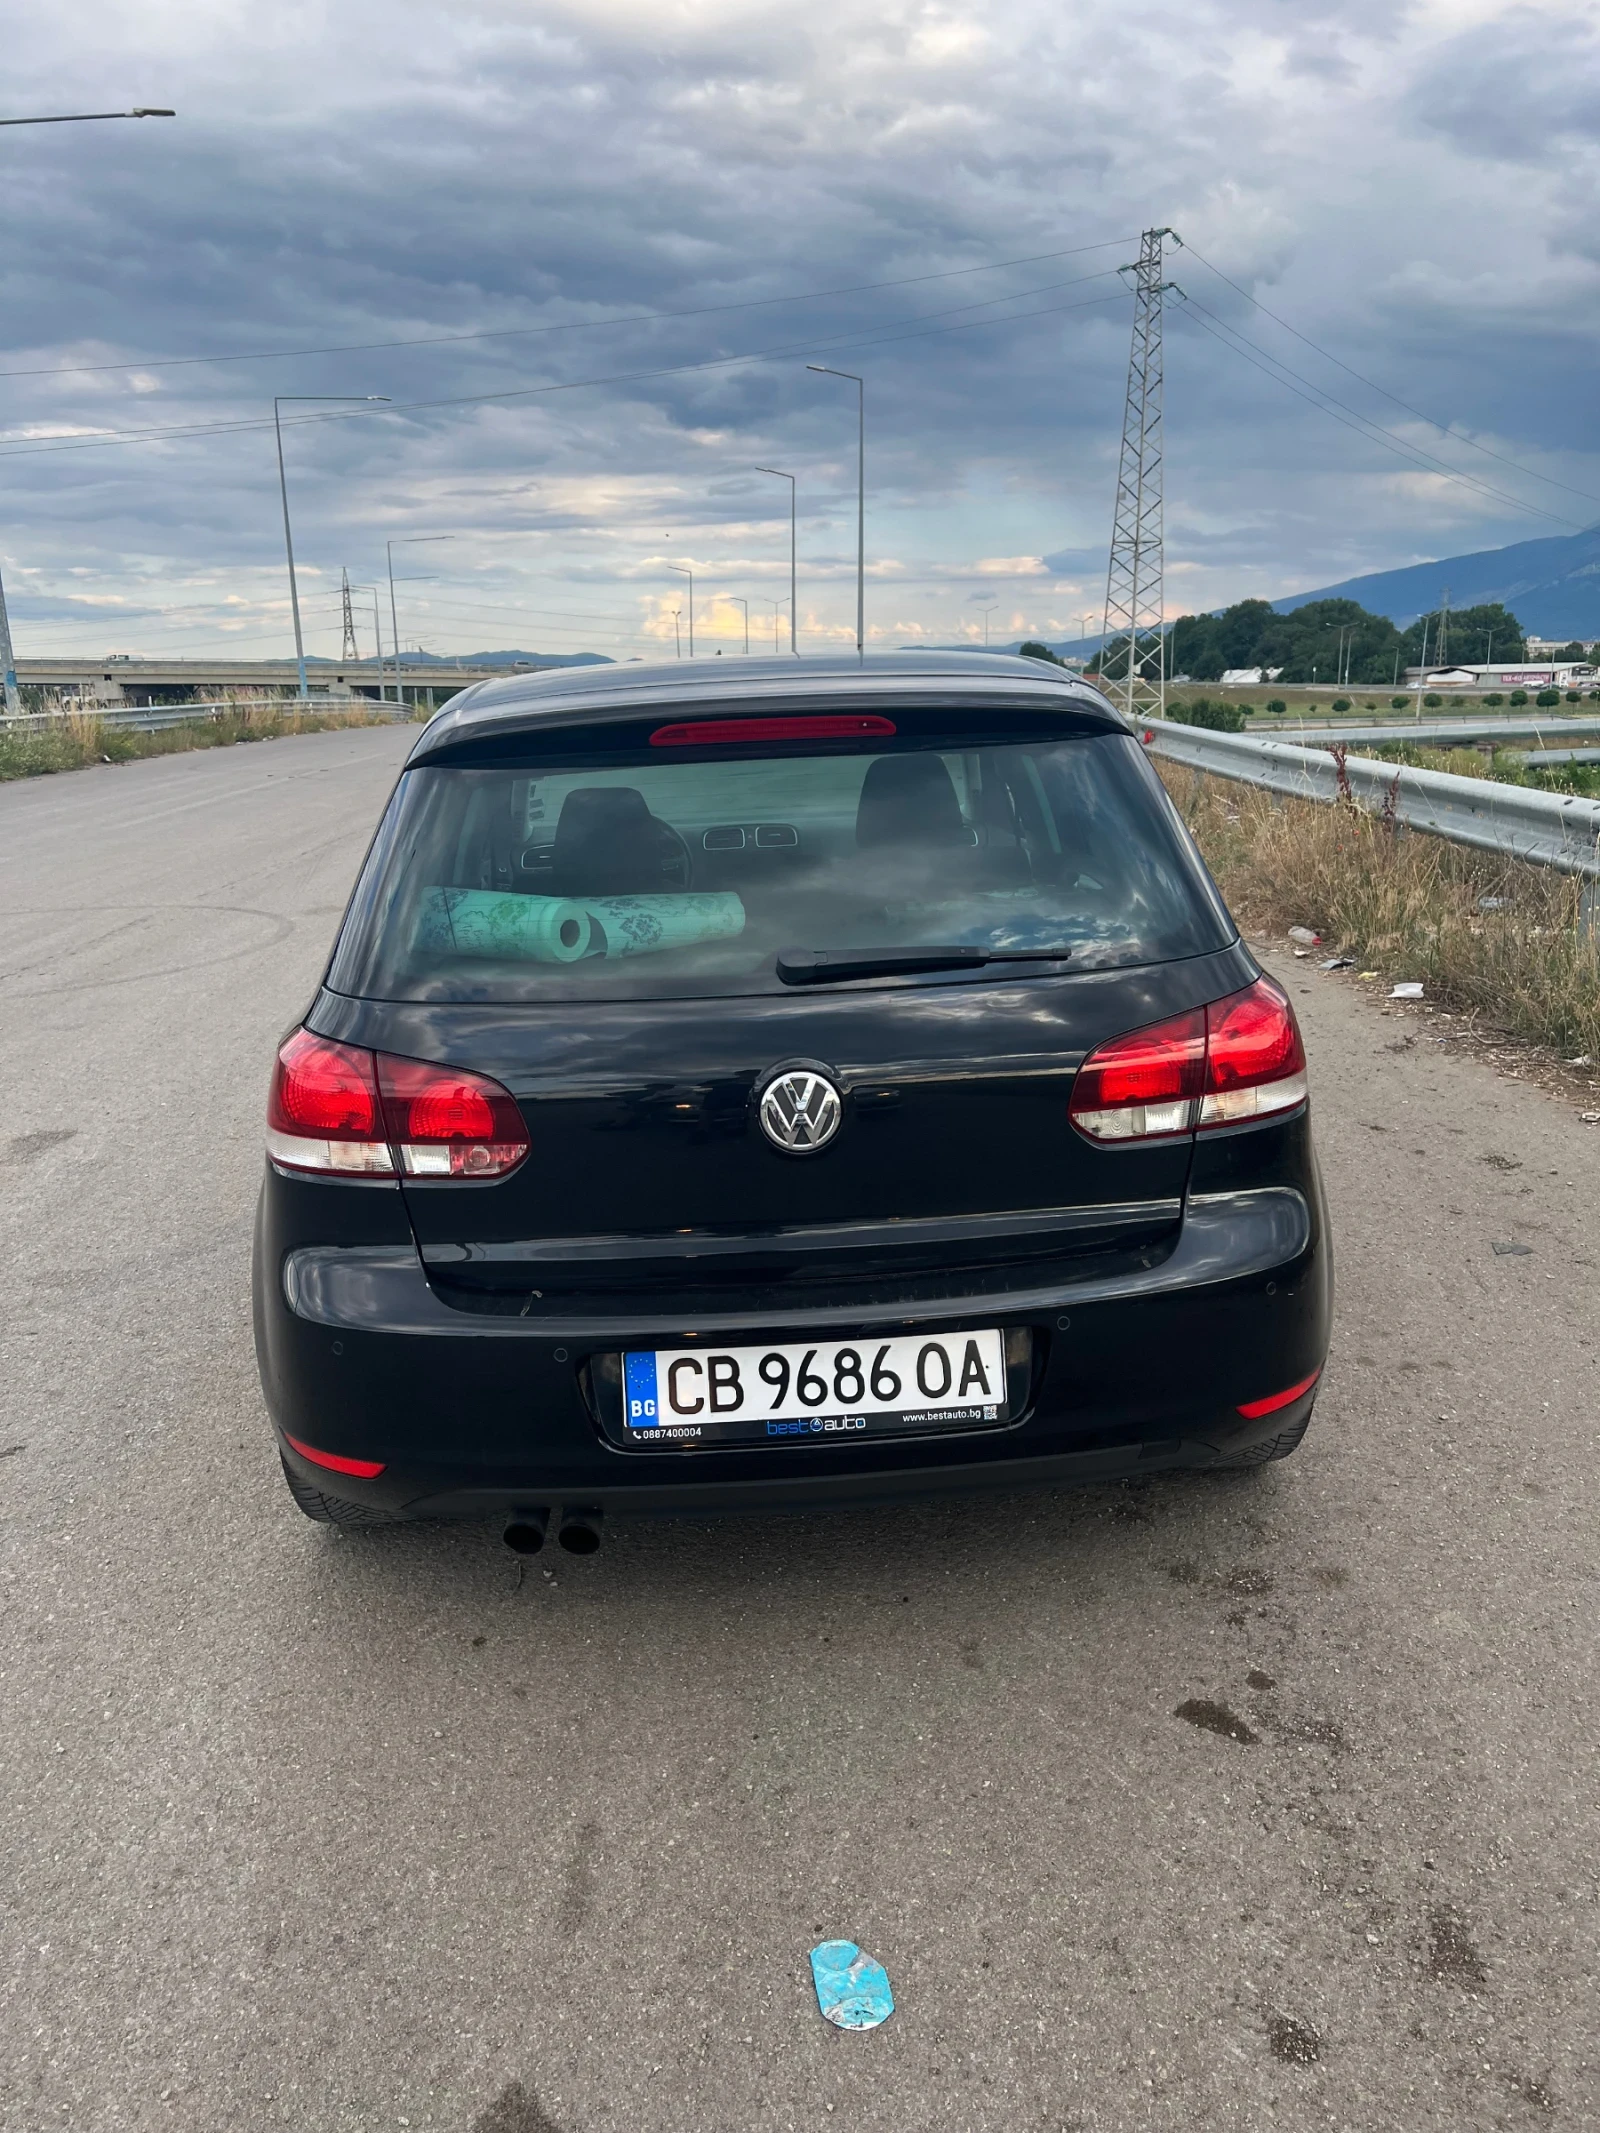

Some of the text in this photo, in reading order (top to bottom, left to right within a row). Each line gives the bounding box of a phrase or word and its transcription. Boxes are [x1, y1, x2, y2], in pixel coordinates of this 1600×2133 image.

[668, 1339, 992, 1415] CB 9686 OA
[631, 1399, 656, 1417] BG
[902, 1408, 981, 1423] www.bestauto.bg
[642, 1427, 702, 1440] 0887400004
